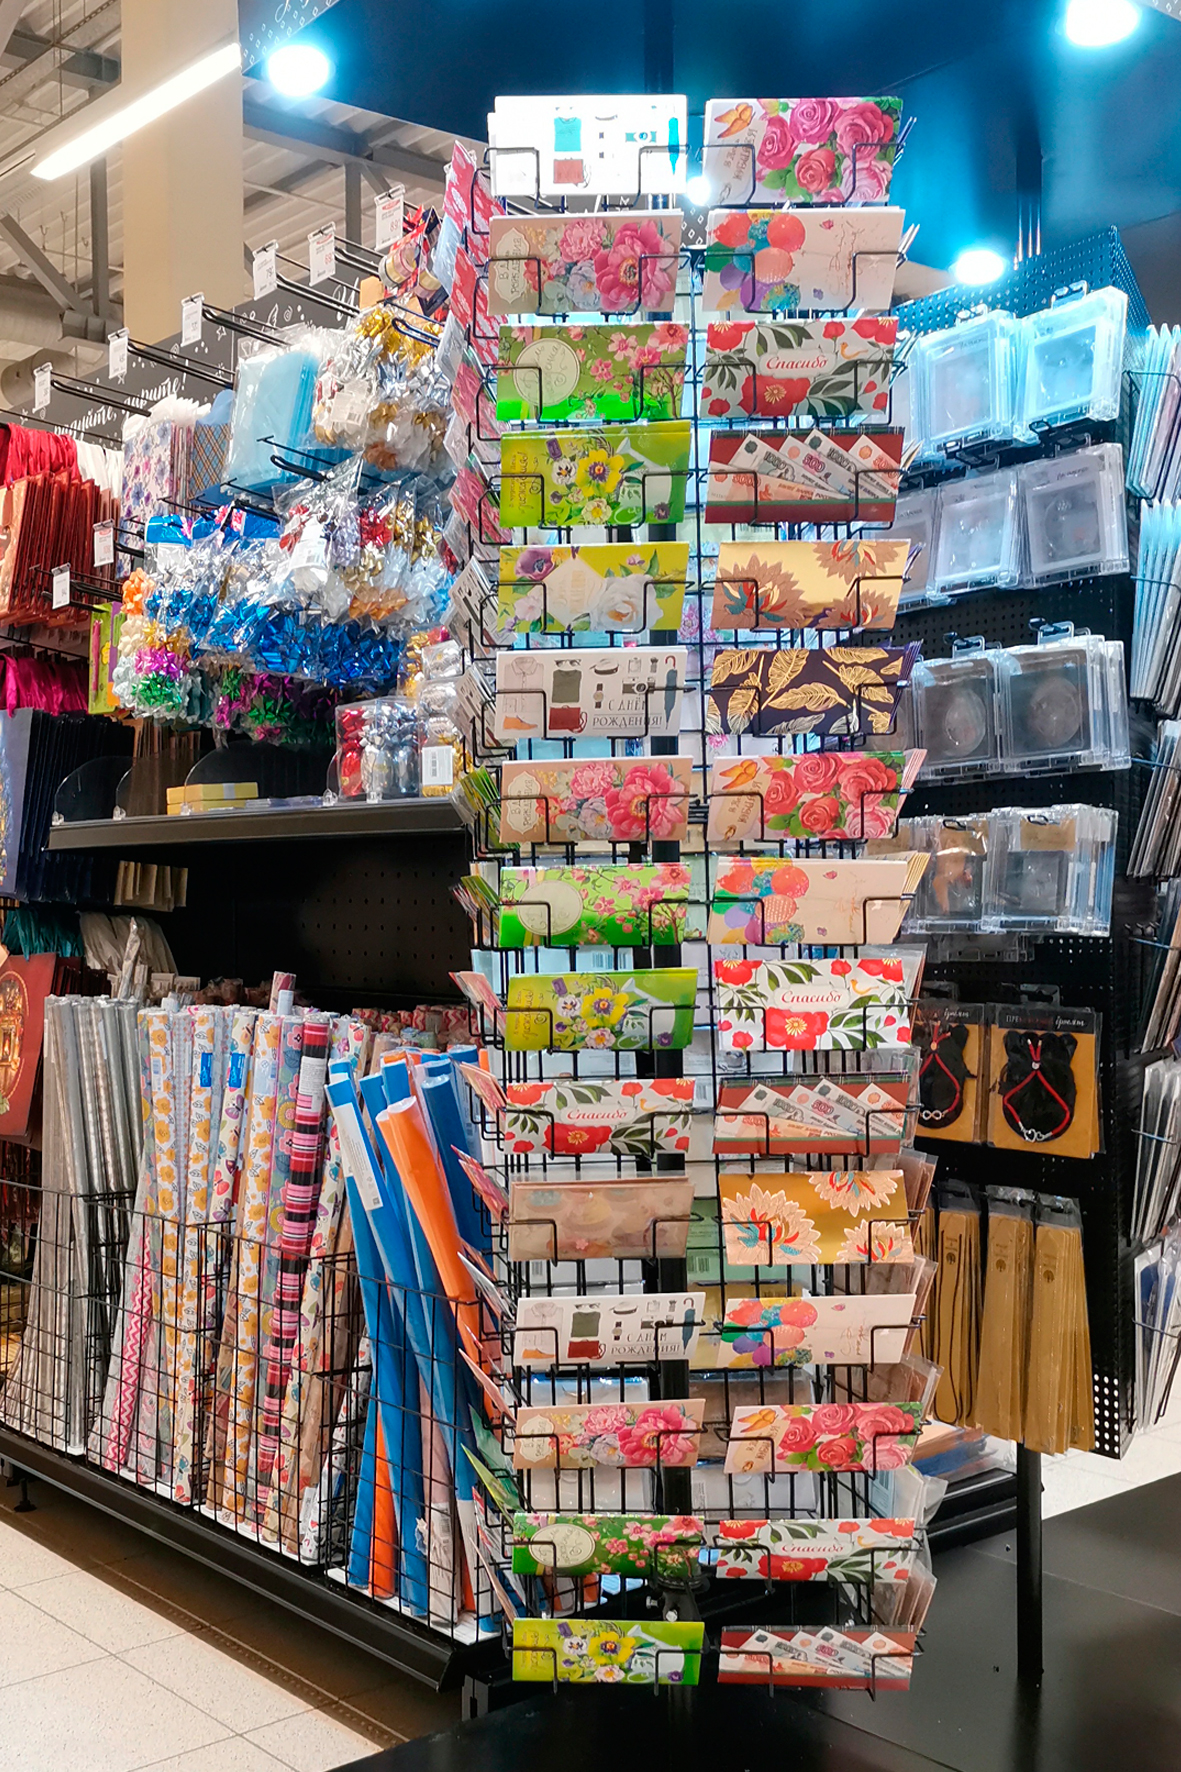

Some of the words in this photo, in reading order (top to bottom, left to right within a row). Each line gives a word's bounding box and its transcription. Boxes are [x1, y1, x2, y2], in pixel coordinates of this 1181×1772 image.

[766, 354, 828, 370] Спасибо
[802, 453, 826, 472] 500
[608, 700, 615, 711] С
[592, 716, 662, 728] РОЖДЕНЯ!
[781, 990, 842, 1004] Спасибо
[811, 1099, 834, 1115] 500
[567, 1109, 628, 1120] Спасибо
[637, 1332, 667, 1343] ДНМ
[781, 1543, 844, 1553] Спасибо
